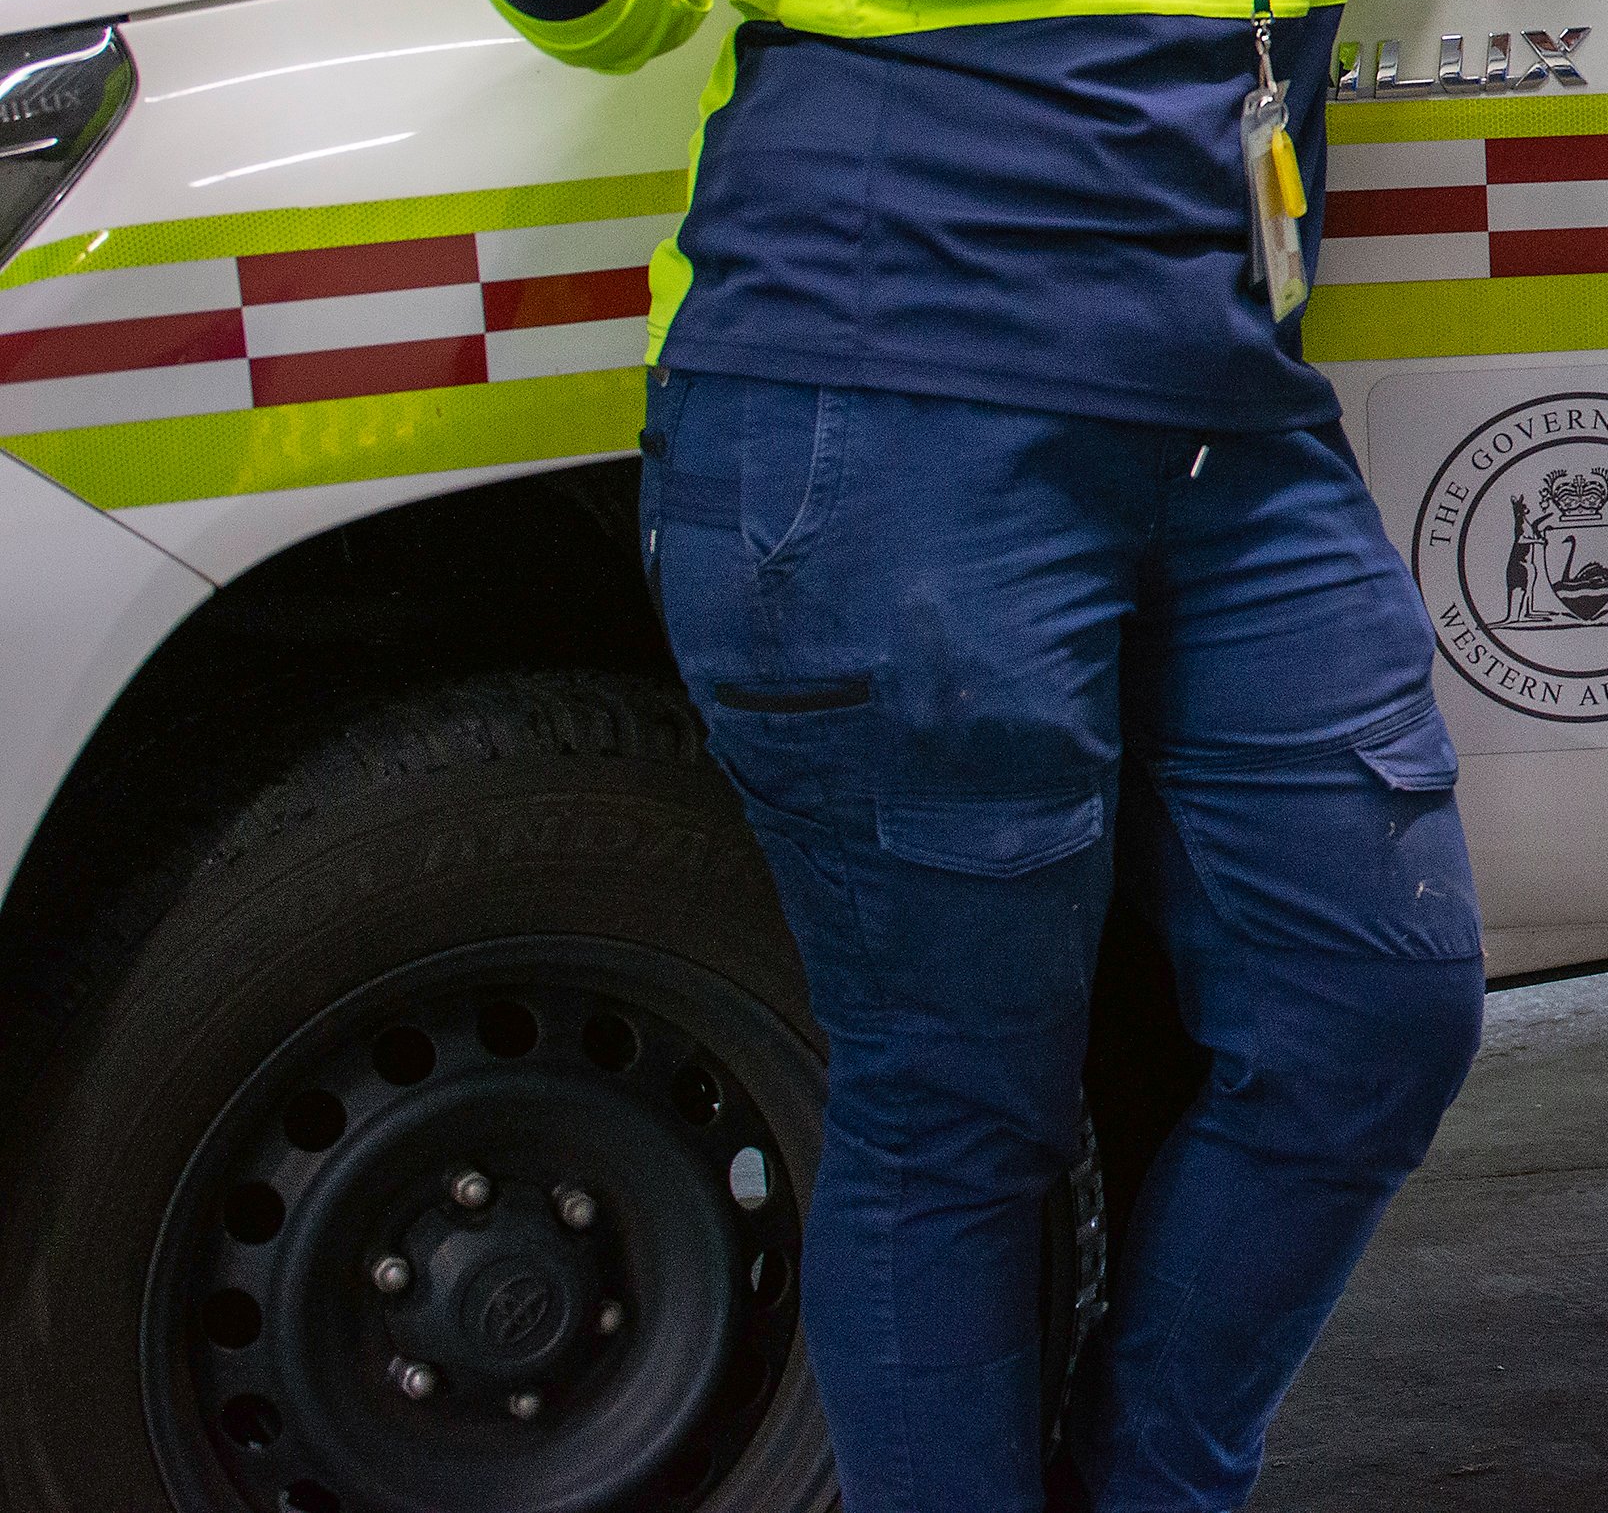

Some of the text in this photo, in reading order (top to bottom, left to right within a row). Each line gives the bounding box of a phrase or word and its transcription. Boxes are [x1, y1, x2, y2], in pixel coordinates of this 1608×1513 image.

[1336, 26, 1593, 100] ILUX
[1429, 481, 1470, 547] THE
[1439, 602, 1564, 705] WESTERN
